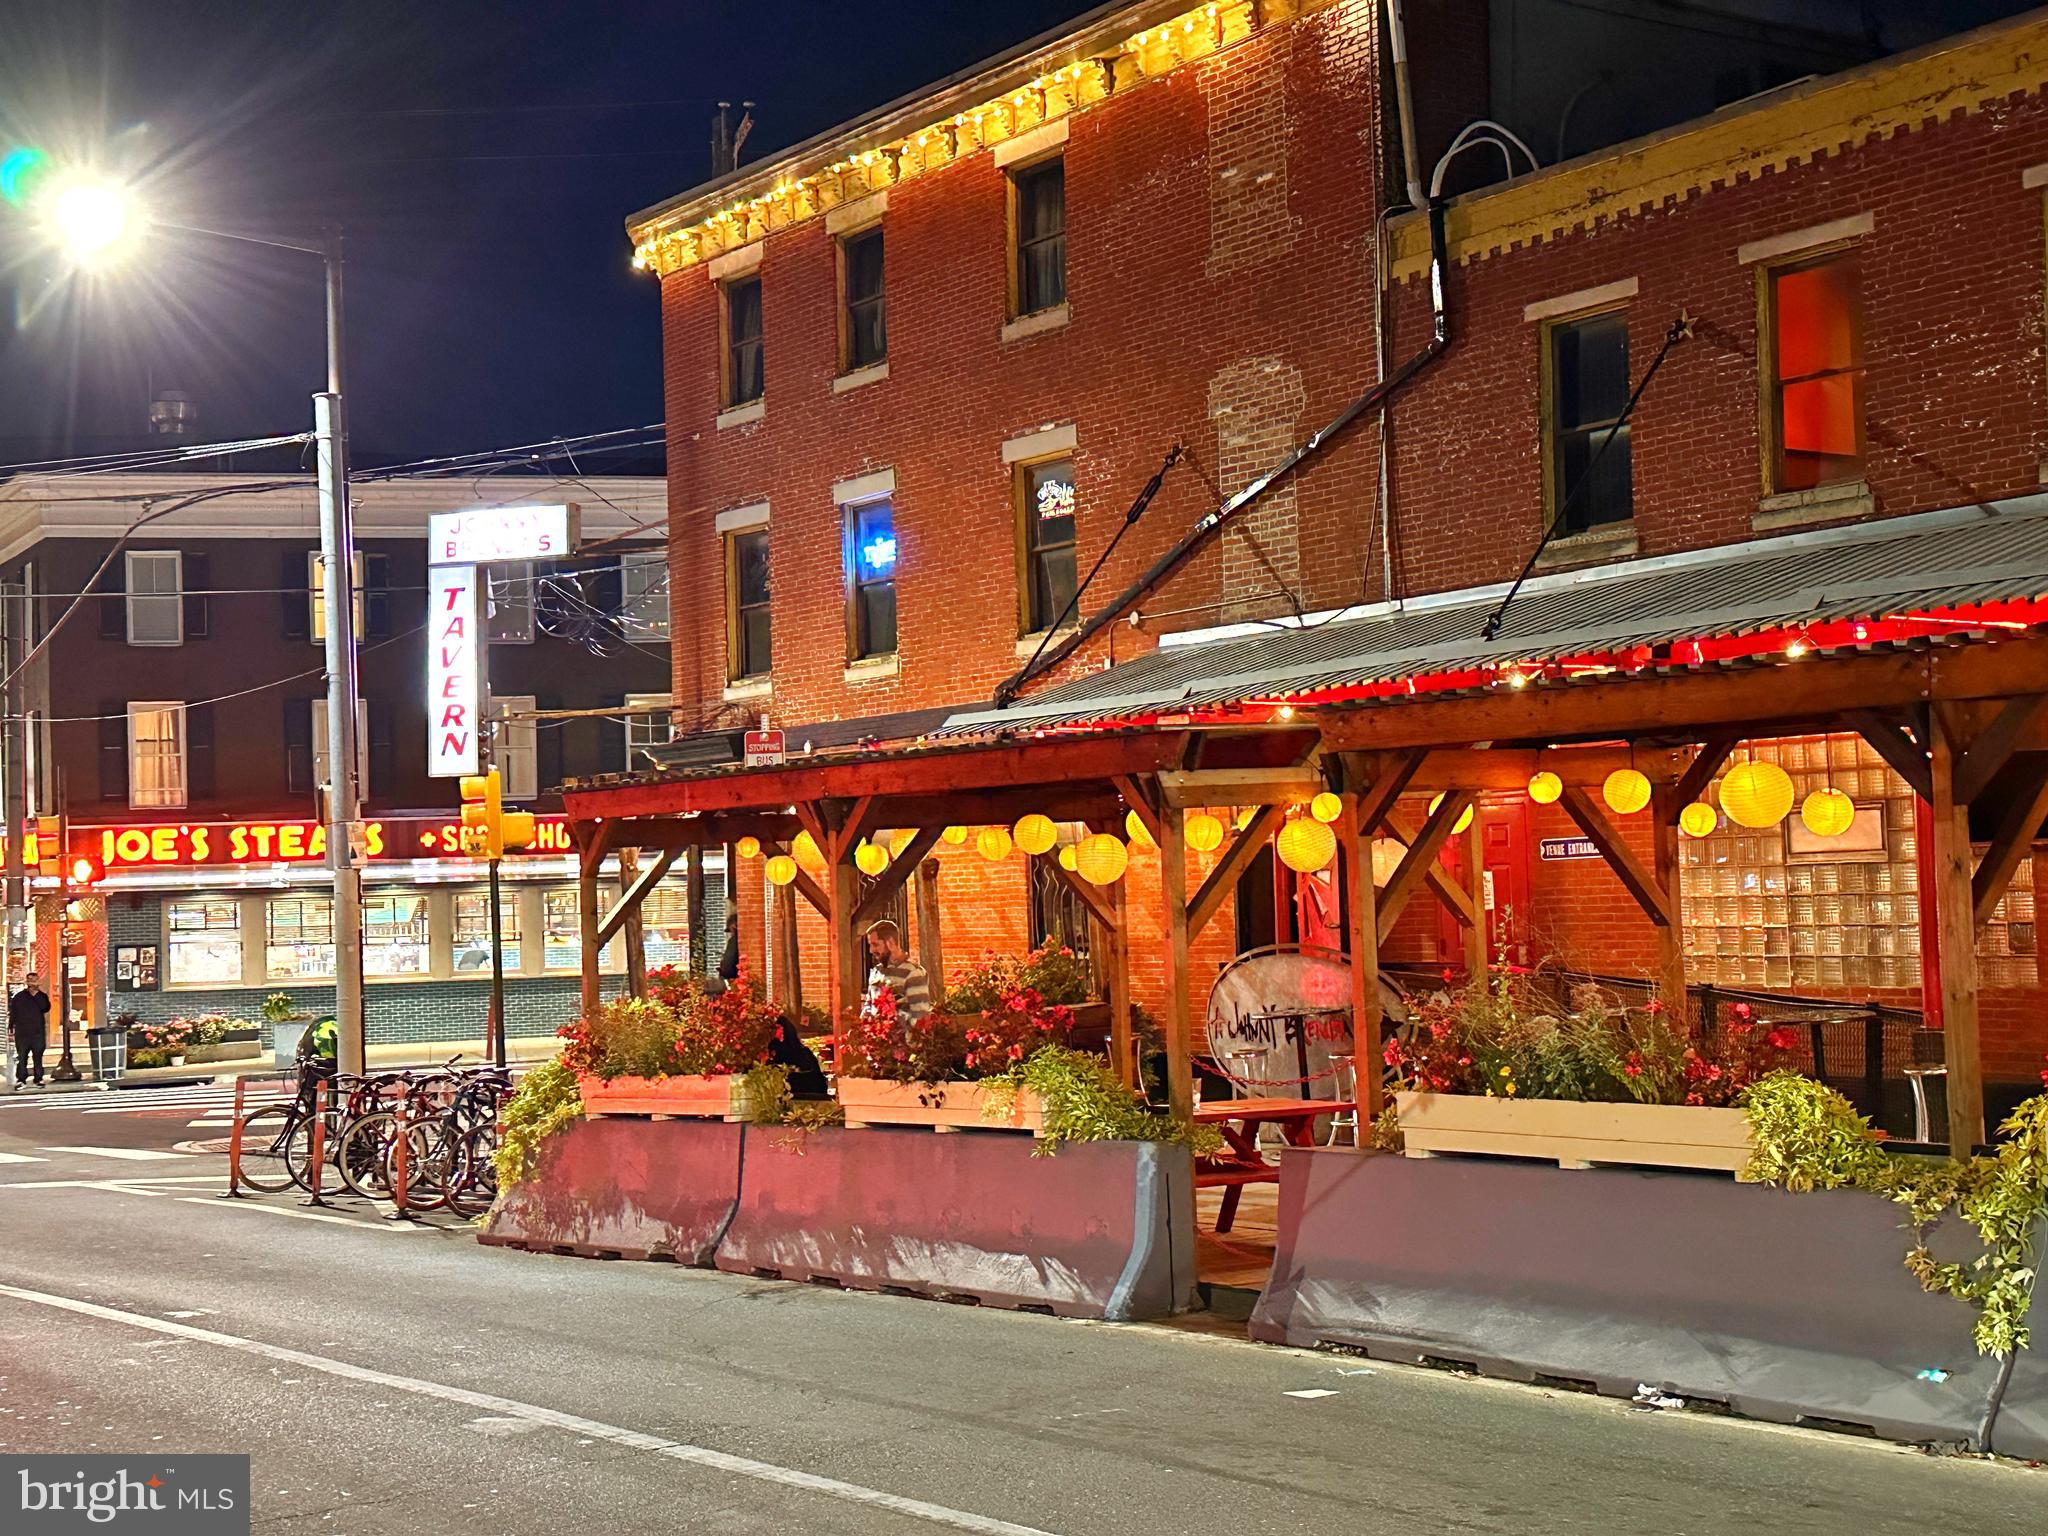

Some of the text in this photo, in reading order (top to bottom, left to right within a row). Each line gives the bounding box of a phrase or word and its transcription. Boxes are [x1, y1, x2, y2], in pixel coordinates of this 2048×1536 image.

[440, 586, 469, 757] TAVERN
[748, 743, 781, 752] STOPPING
[756, 756, 774, 766] BUS
[101, 826, 210, 866] JOE'S
[229, 823, 384, 860] STEAS
